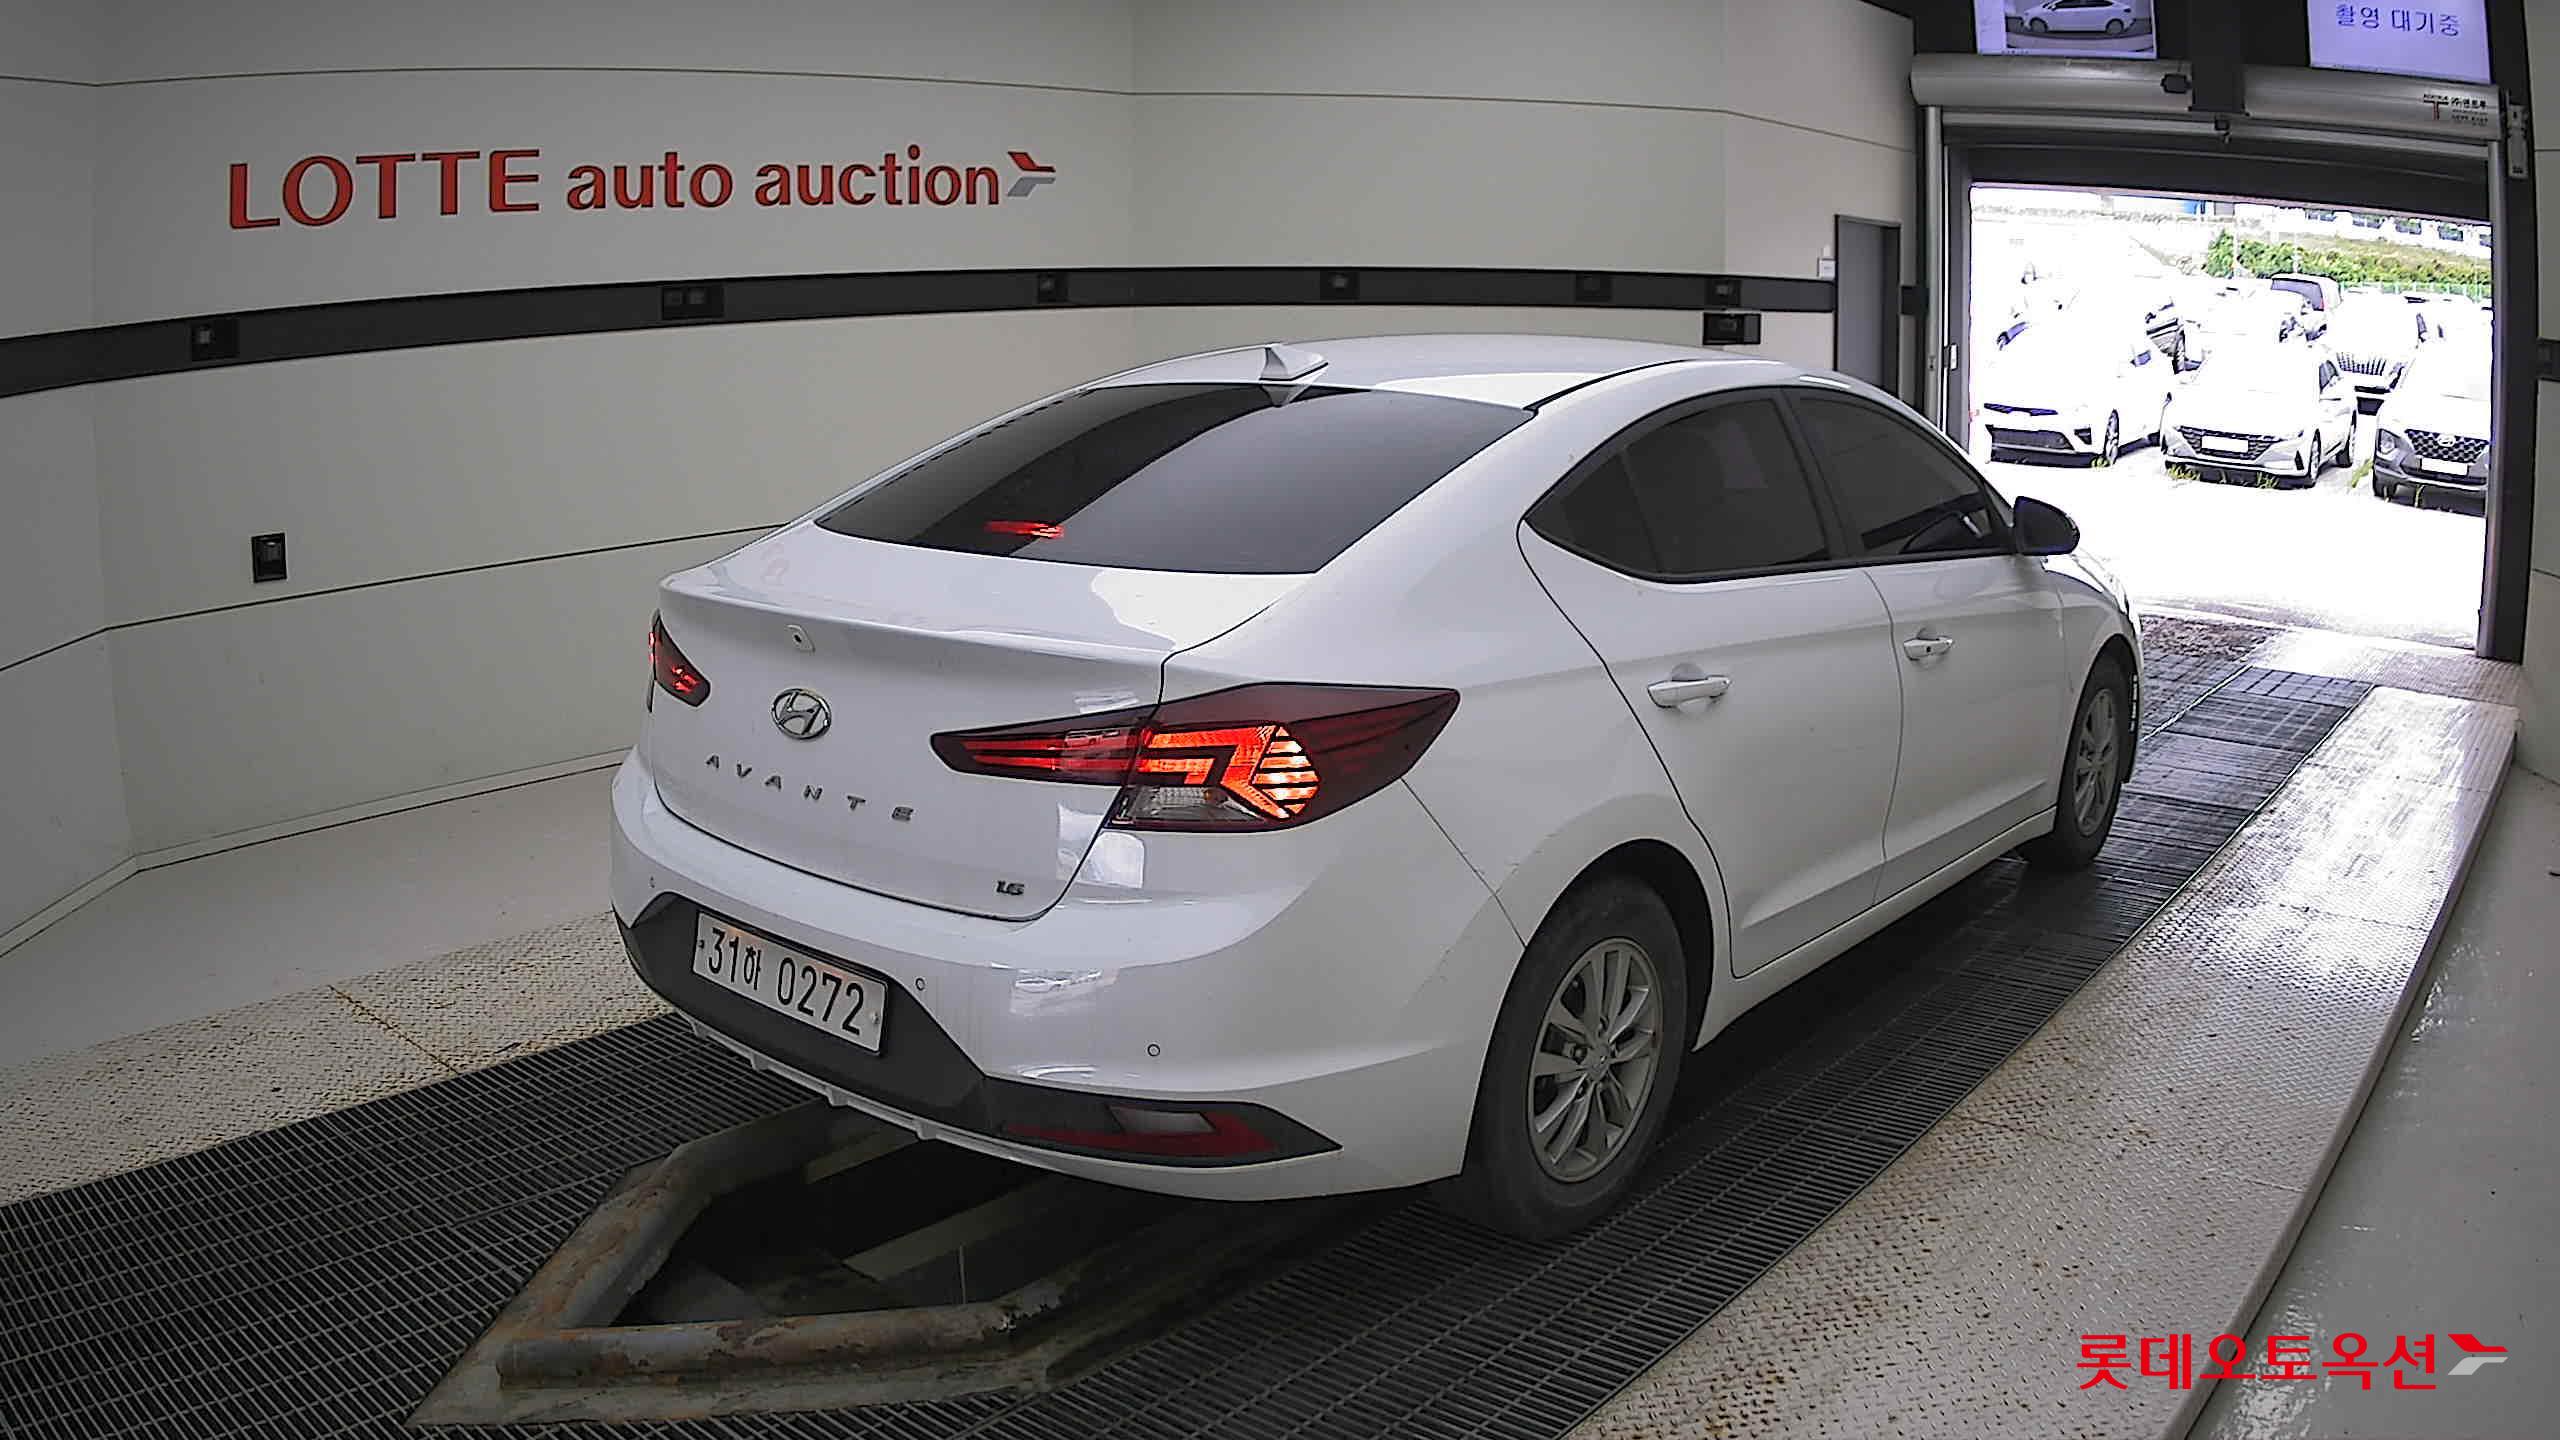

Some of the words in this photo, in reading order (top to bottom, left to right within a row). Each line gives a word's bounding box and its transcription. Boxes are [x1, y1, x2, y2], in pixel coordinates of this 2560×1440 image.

[2391, 9, 2459, 37] 대기중
[229, 148, 541, 230] LOTTE
[566, 151, 734, 209] auto
[754, 144, 1001, 206] auction
[705, 754, 914, 822] AVANTE
[708, 927, 762, 991] 31하
[777, 957, 865, 1036] 0272
